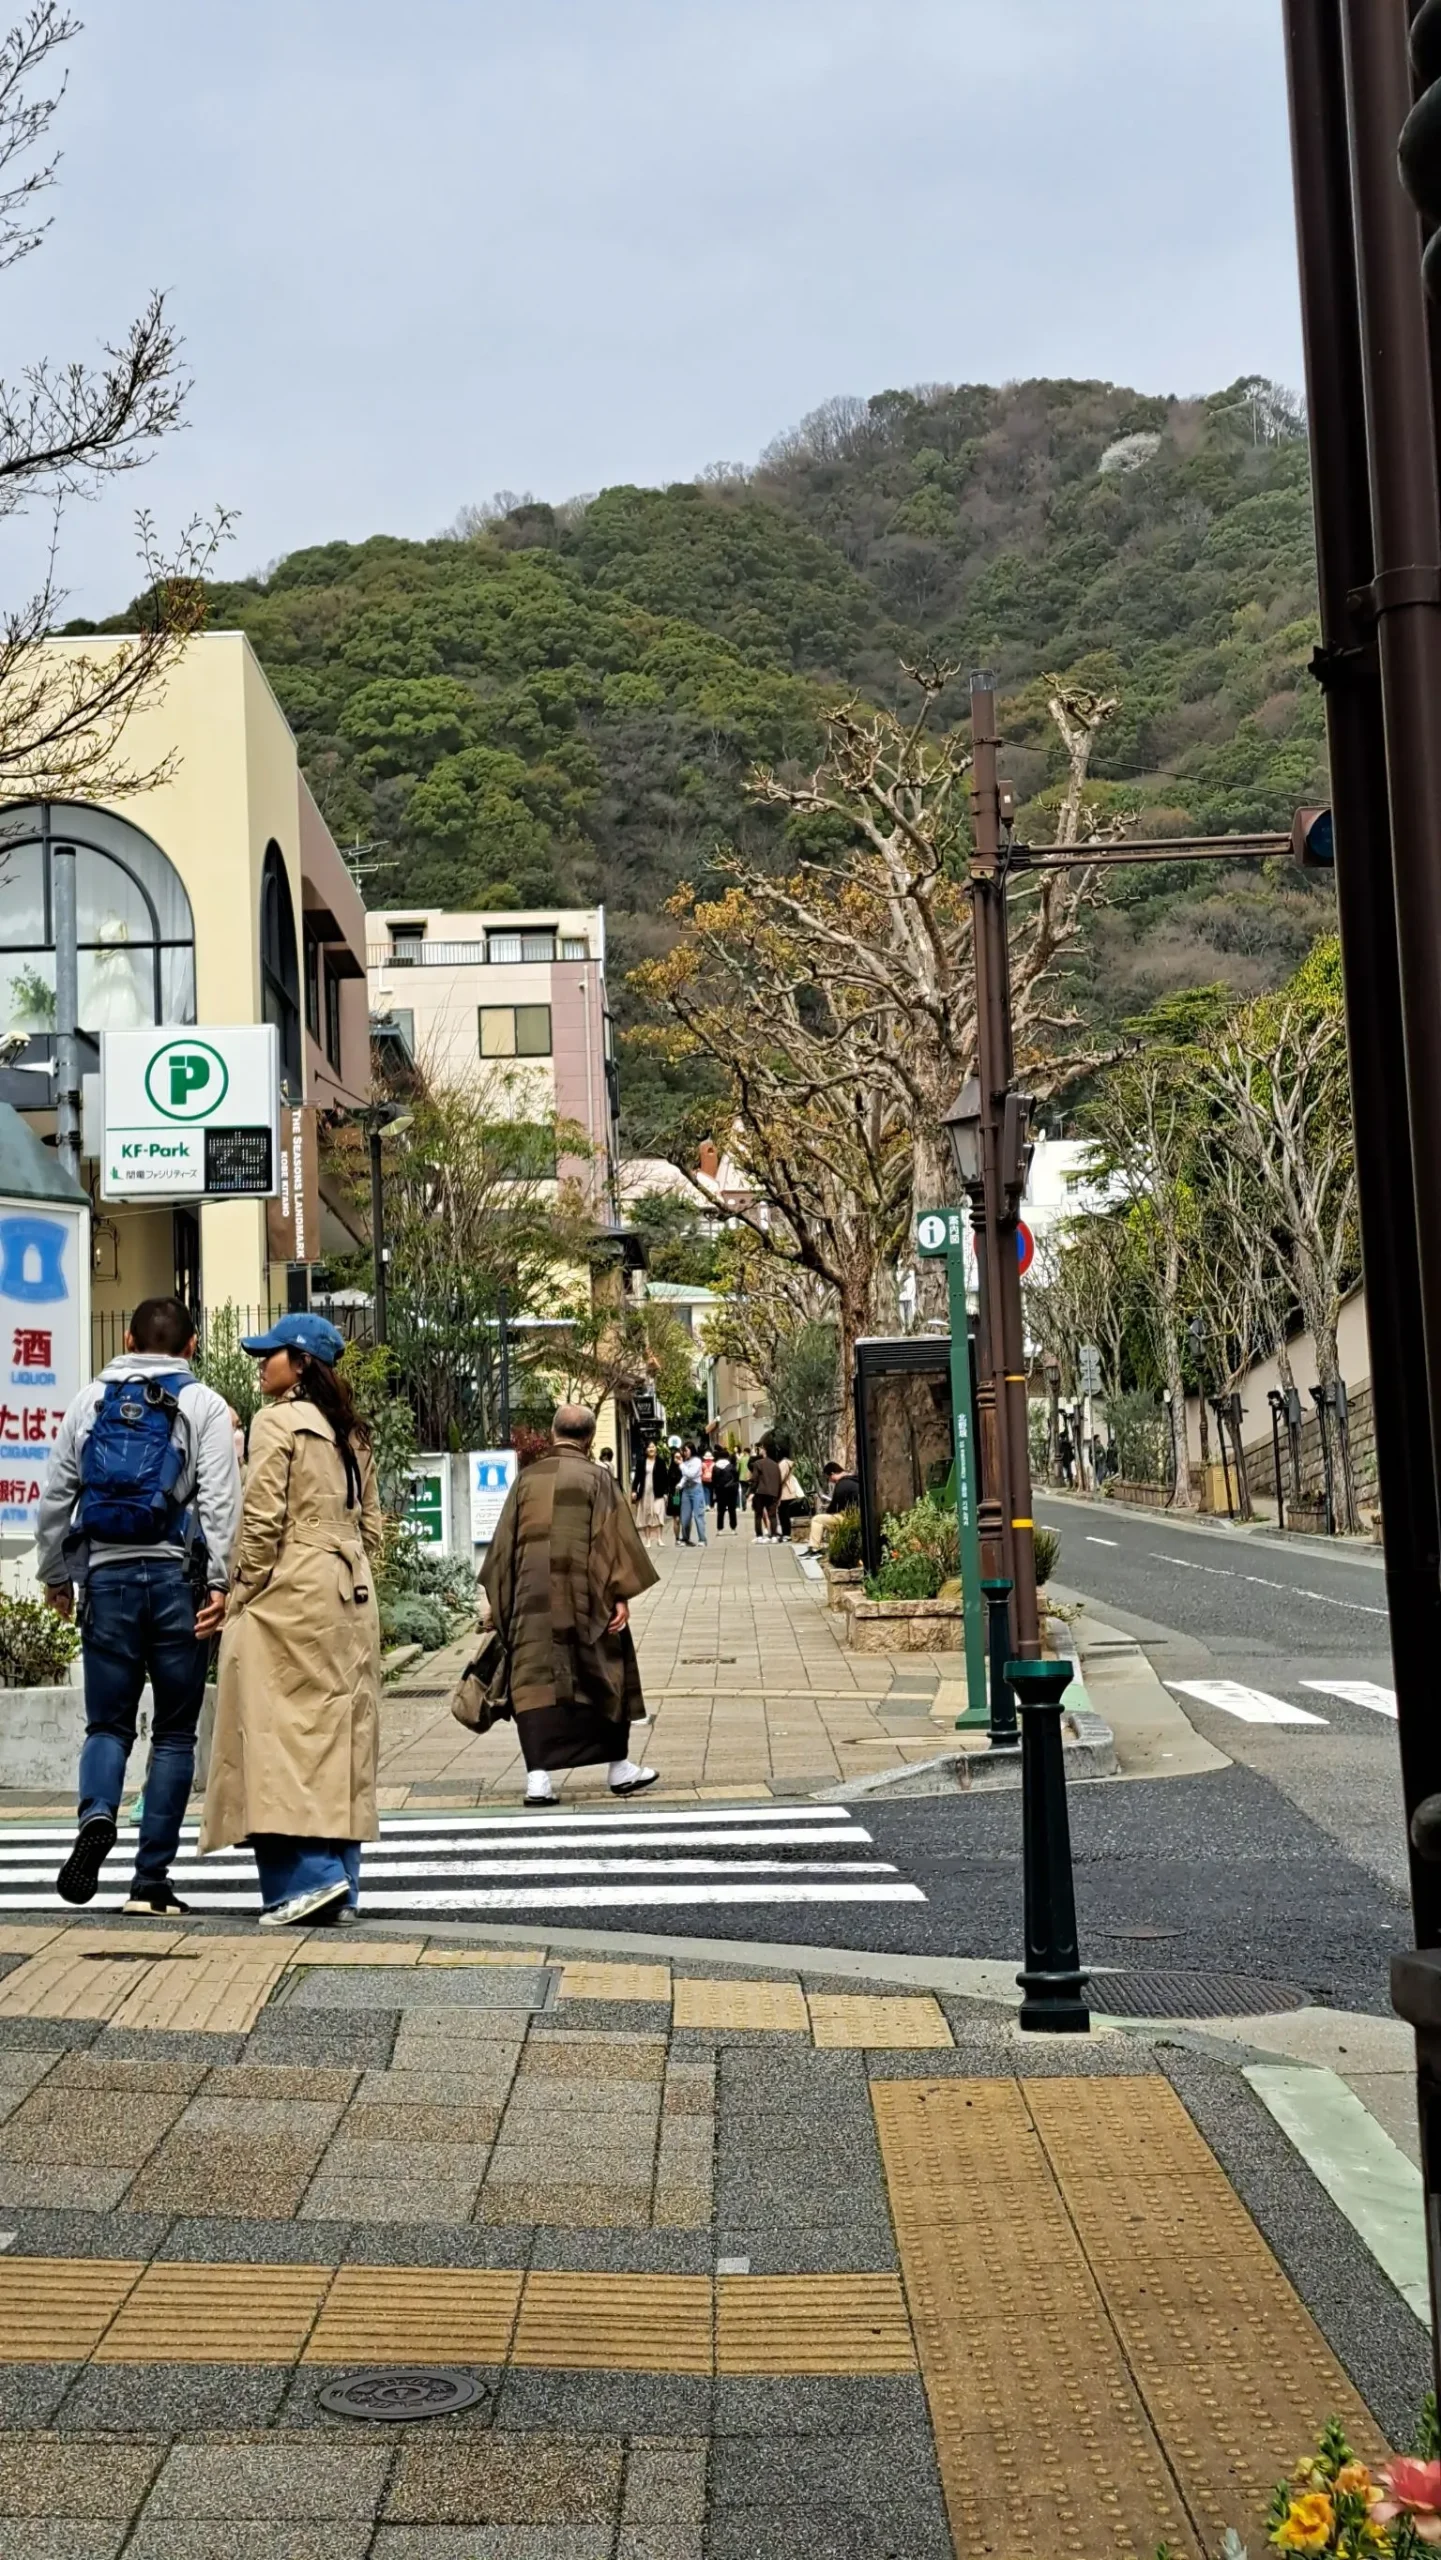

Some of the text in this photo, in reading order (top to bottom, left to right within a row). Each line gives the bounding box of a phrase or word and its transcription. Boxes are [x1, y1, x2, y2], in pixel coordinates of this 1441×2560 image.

[121, 1141, 190, 1158] KF-Park
[281, 1151, 290, 1218] KOBE KITANO
[292, 1109, 305, 1259] THE SEASONS LANDMARK
[948, 1215, 960, 1245] 案内図
[12, 1328, 53, 1368] 酒
[11, 1371, 56, 1385] LIQUOR
